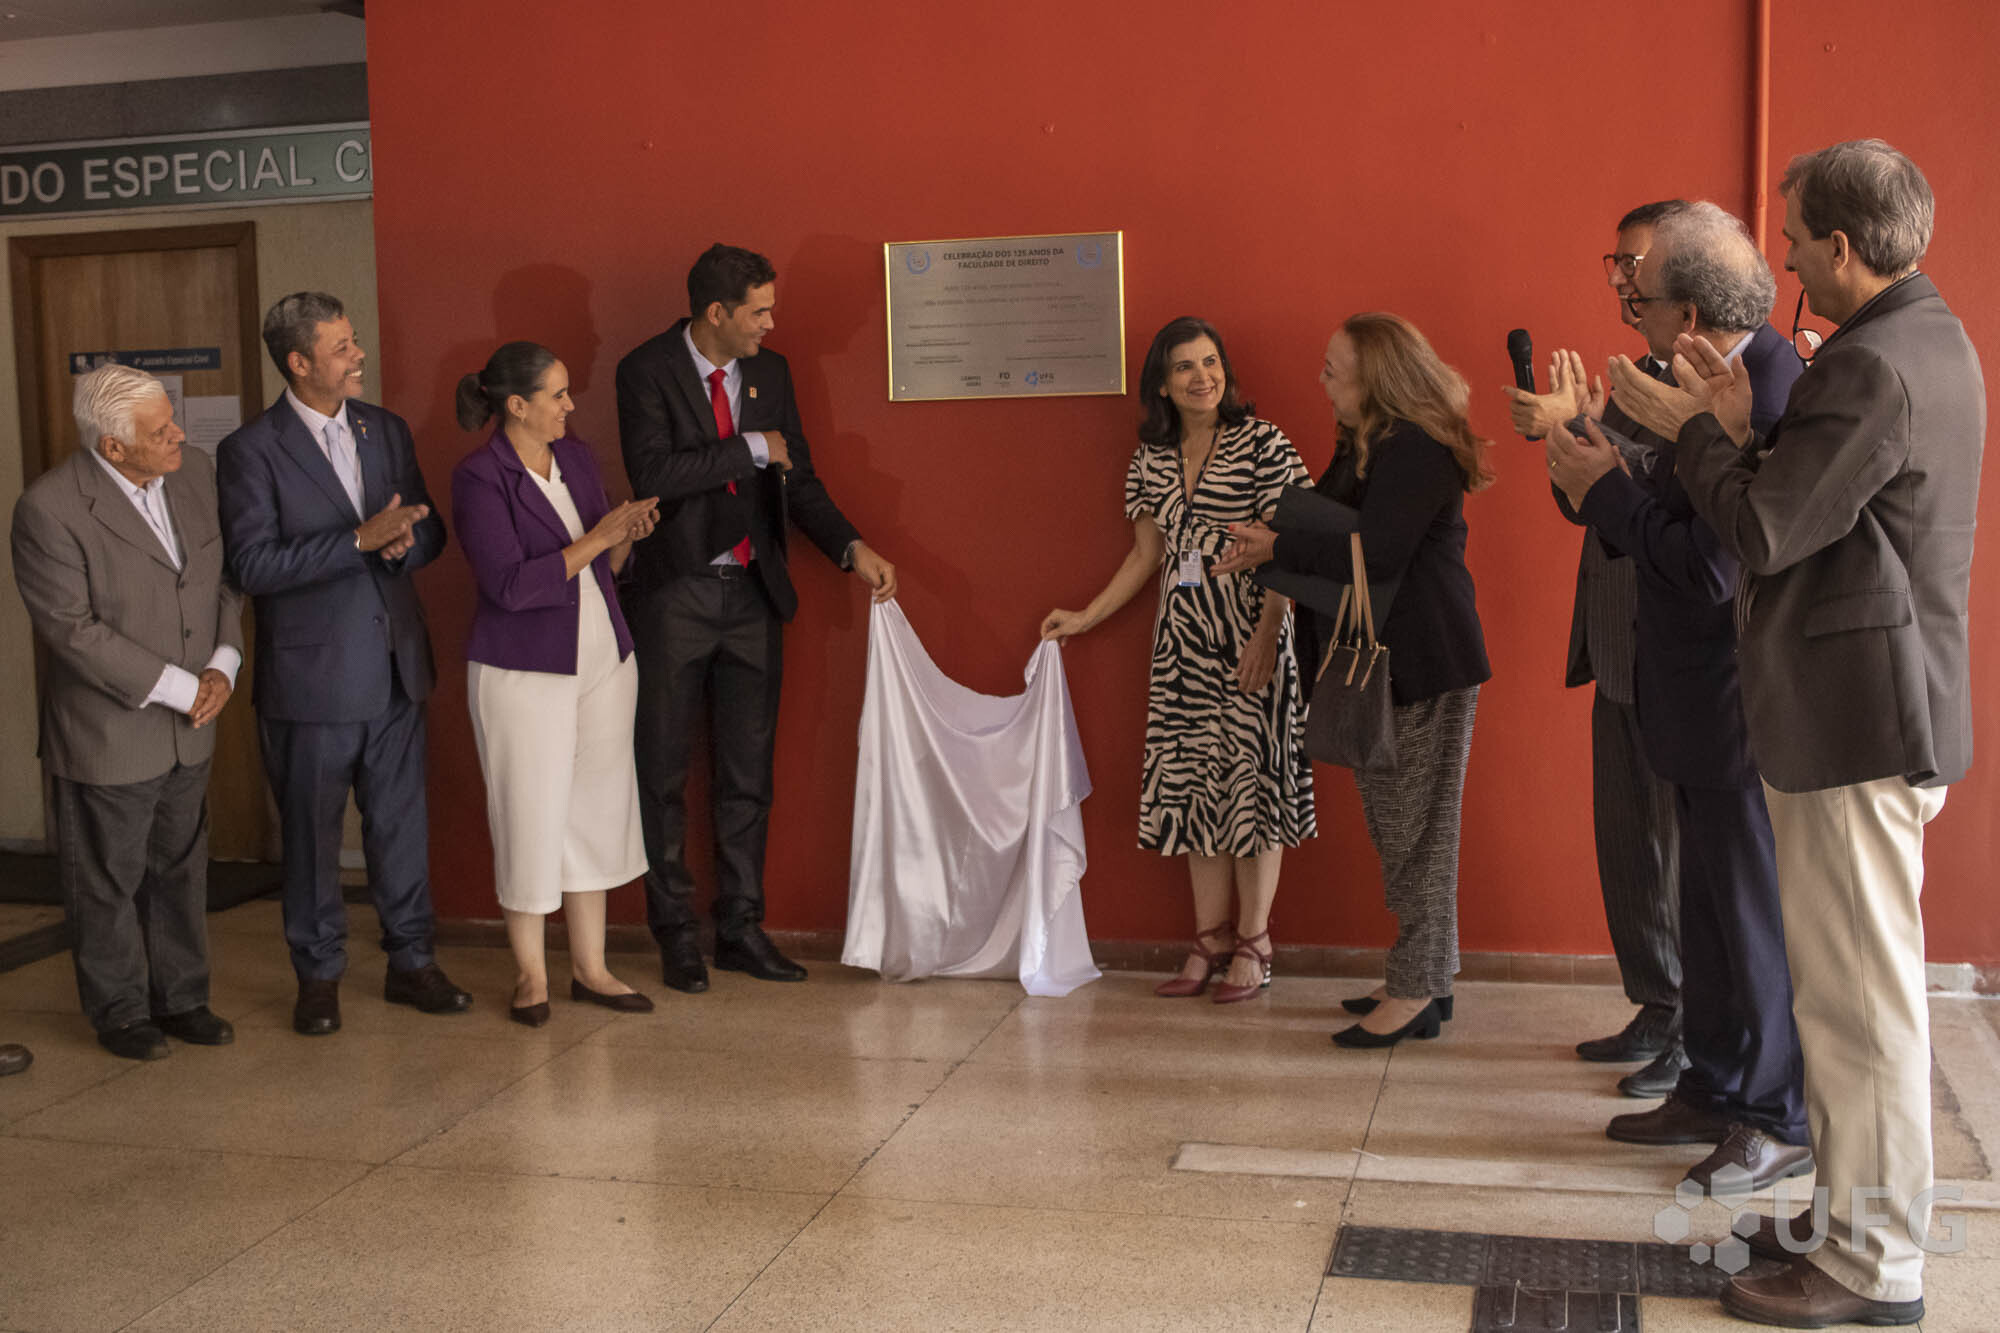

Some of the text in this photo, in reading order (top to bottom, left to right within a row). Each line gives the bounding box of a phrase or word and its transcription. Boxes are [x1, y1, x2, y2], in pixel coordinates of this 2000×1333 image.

[1, 161, 65, 204] DO
[83, 146, 315, 200] ESPECIAL
[943, 247, 1064, 261] CELEBRAÇÃO DOS 125 ANOS DA
[958, 257, 1050, 270] FACULDADE DE DIREITO
